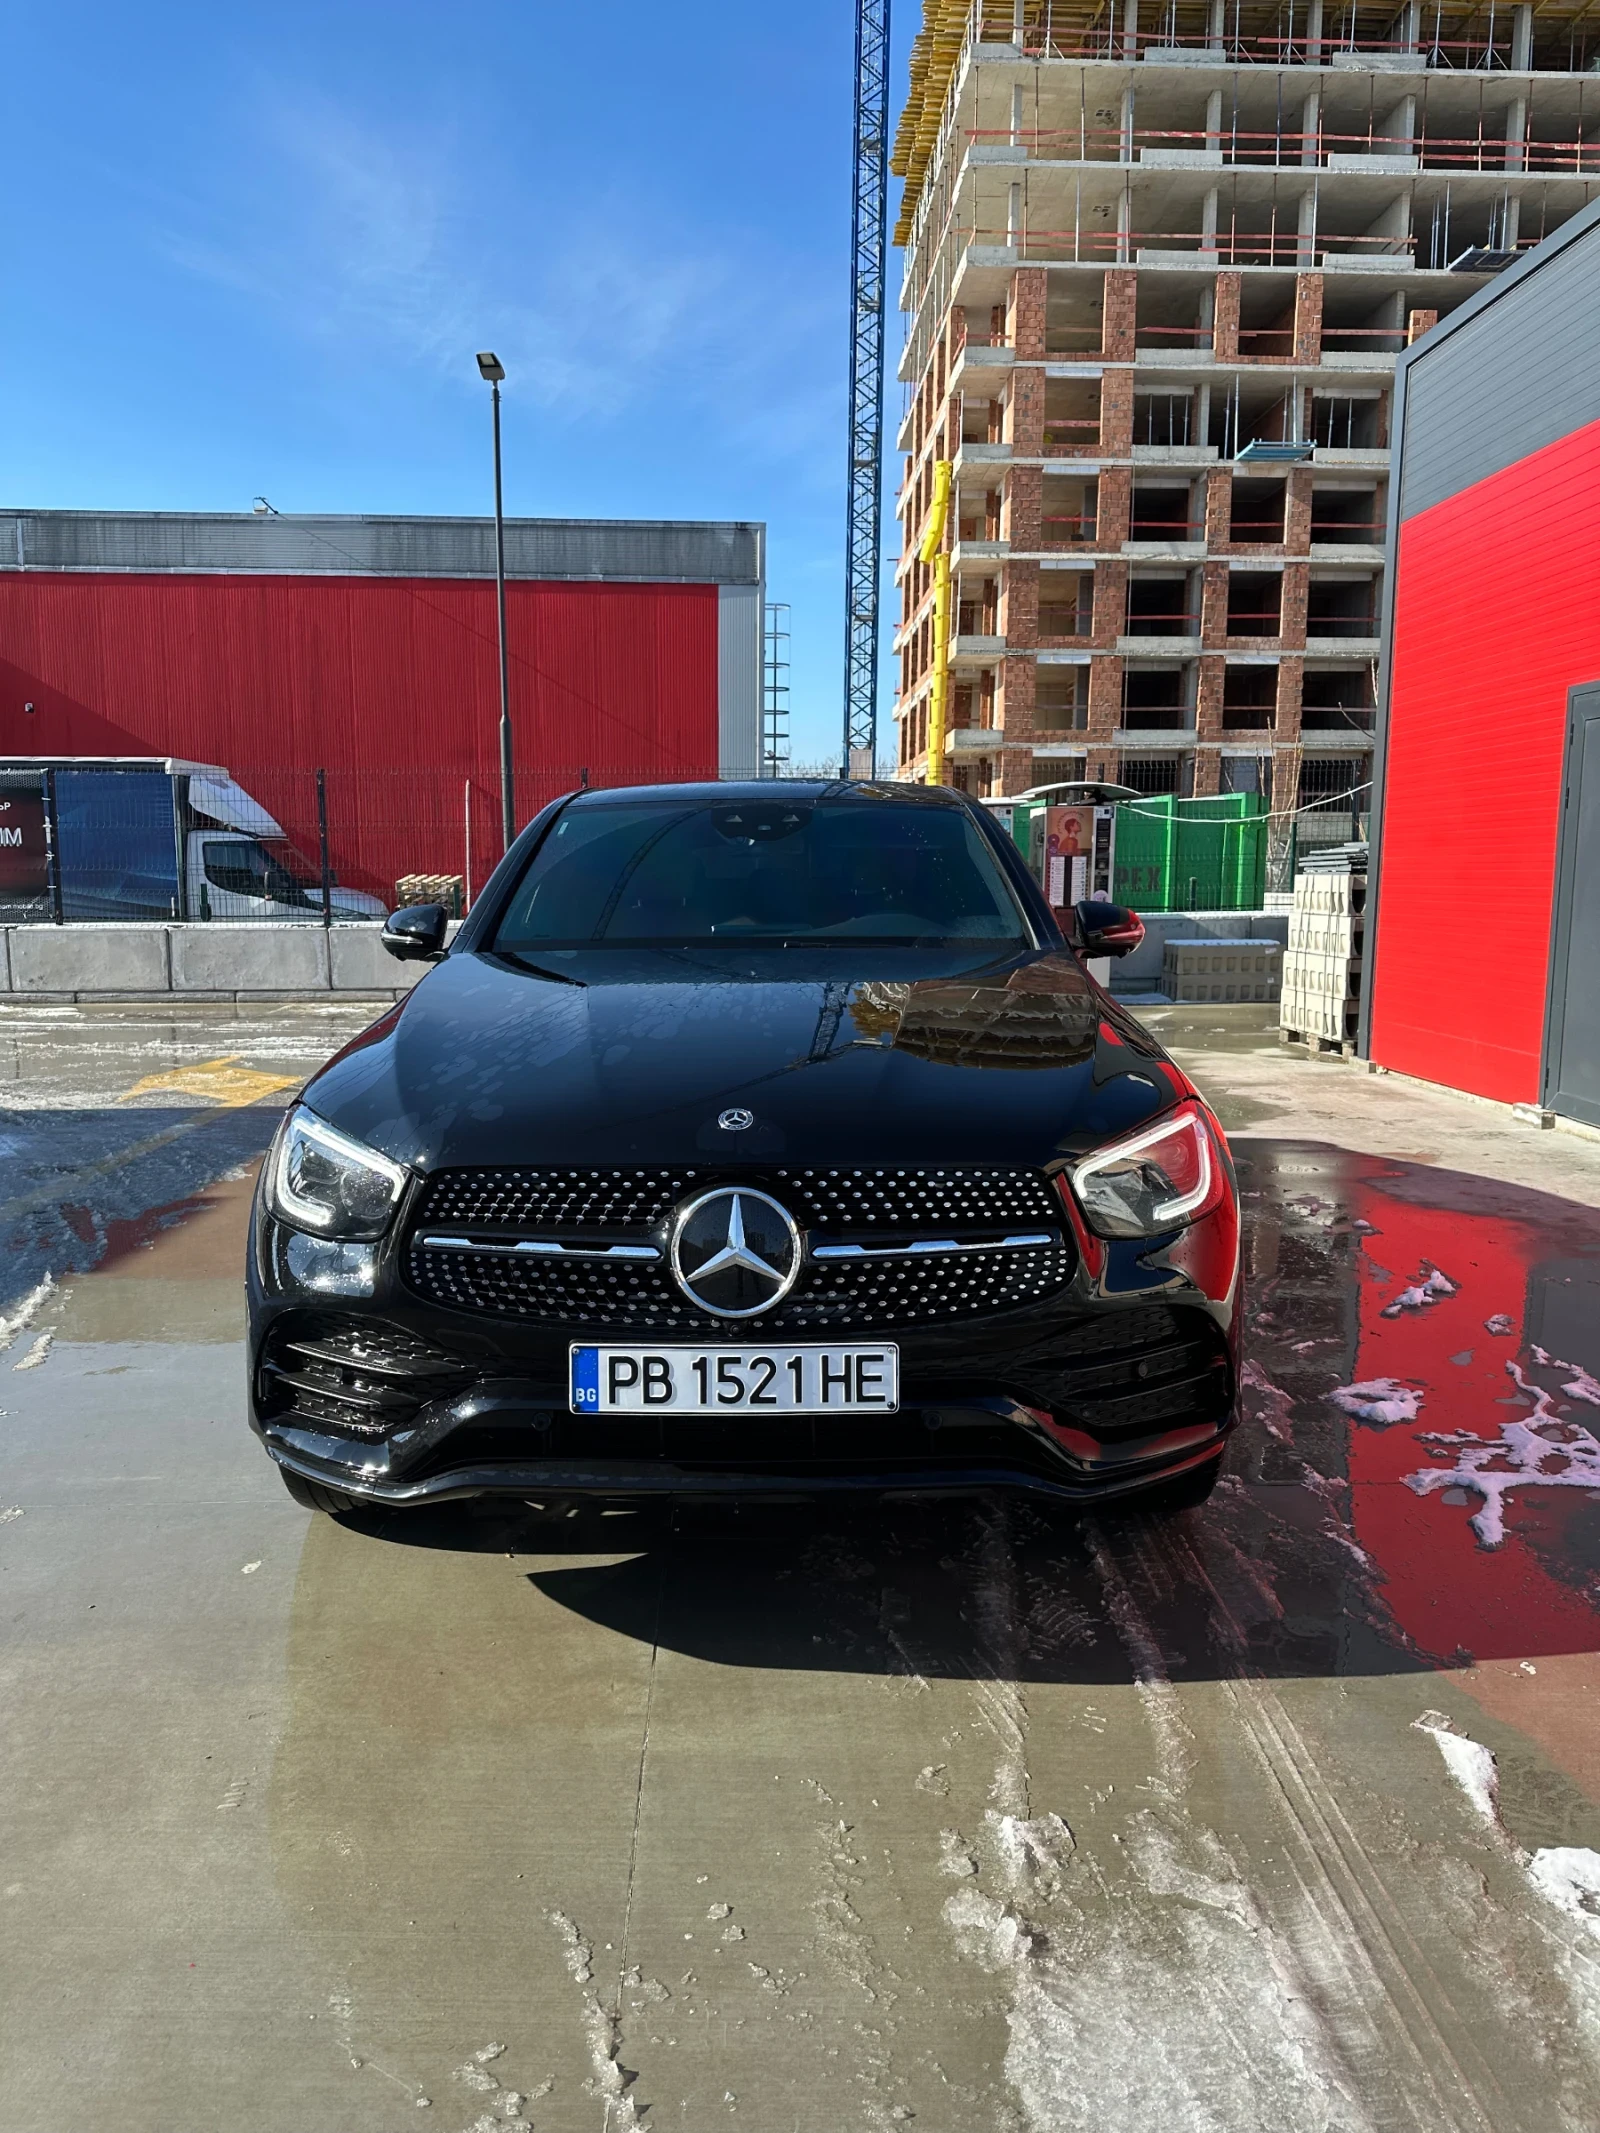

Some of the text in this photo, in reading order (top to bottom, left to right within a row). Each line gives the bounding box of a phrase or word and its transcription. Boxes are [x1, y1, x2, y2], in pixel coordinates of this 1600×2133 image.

[575, 1387, 597, 1402] BG
[608, 1354, 886, 1405] PB 1521 HE
